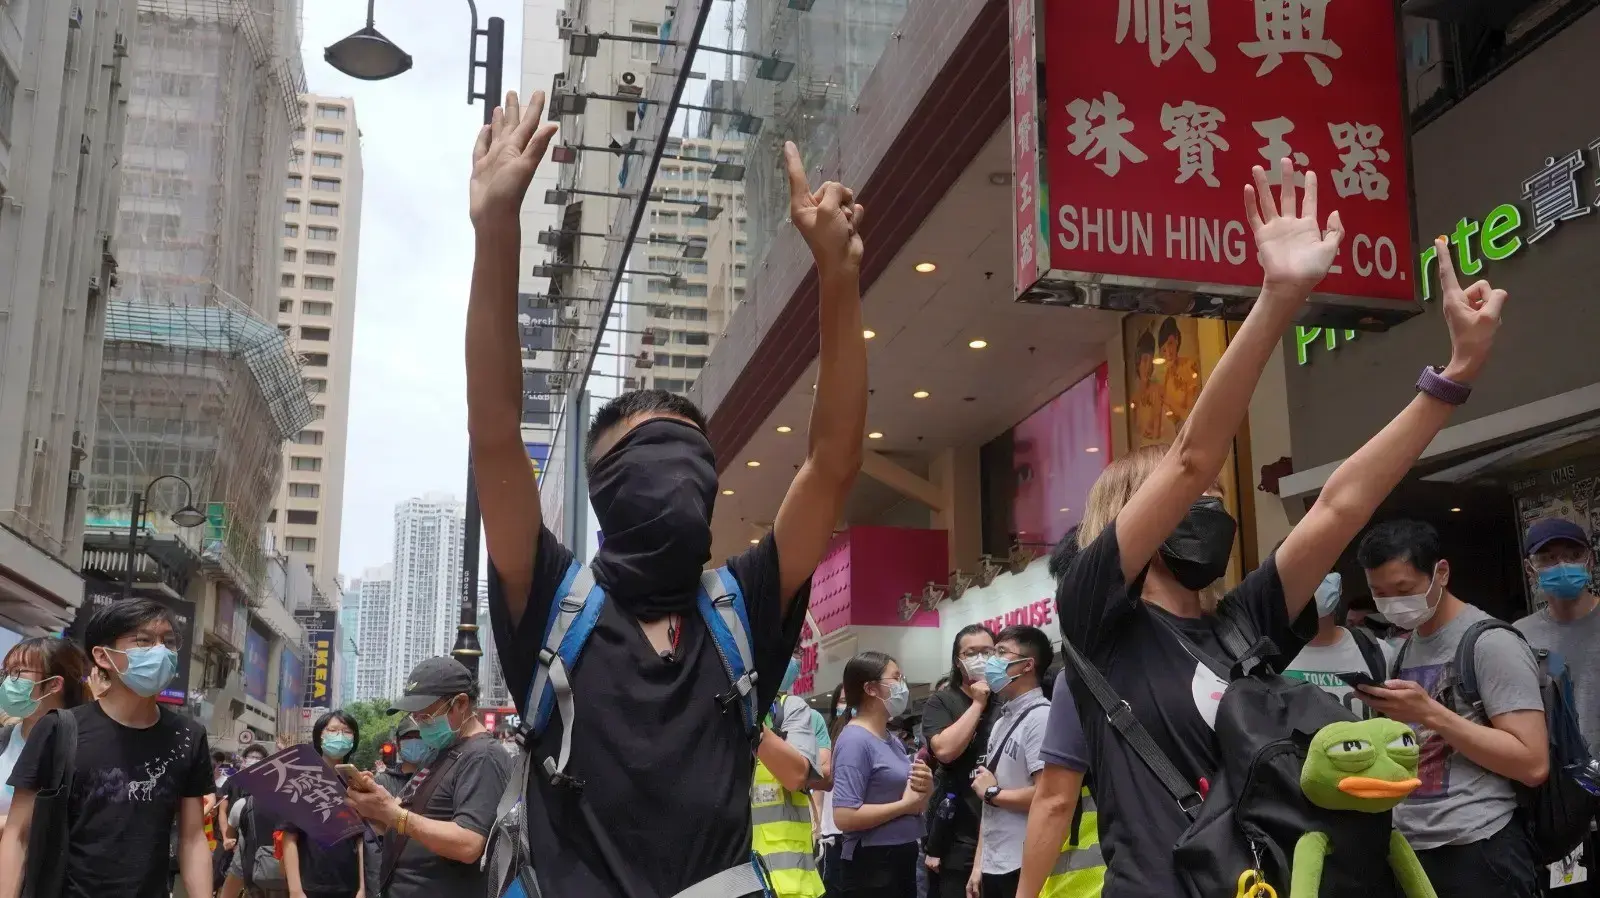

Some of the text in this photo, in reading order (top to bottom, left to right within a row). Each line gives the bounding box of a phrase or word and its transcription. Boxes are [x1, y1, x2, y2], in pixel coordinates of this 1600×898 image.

[1065, 91, 1391, 201] 珠寶玉器
[1520, 137, 1600, 244] 實
[1058, 204, 1154, 258] SHUN
[1165, 214, 1248, 266] HING
[1352, 233, 1406, 281] CO.
[1004, 597, 1052, 628] HOUSE
[314, 640, 330, 699] IKEA
